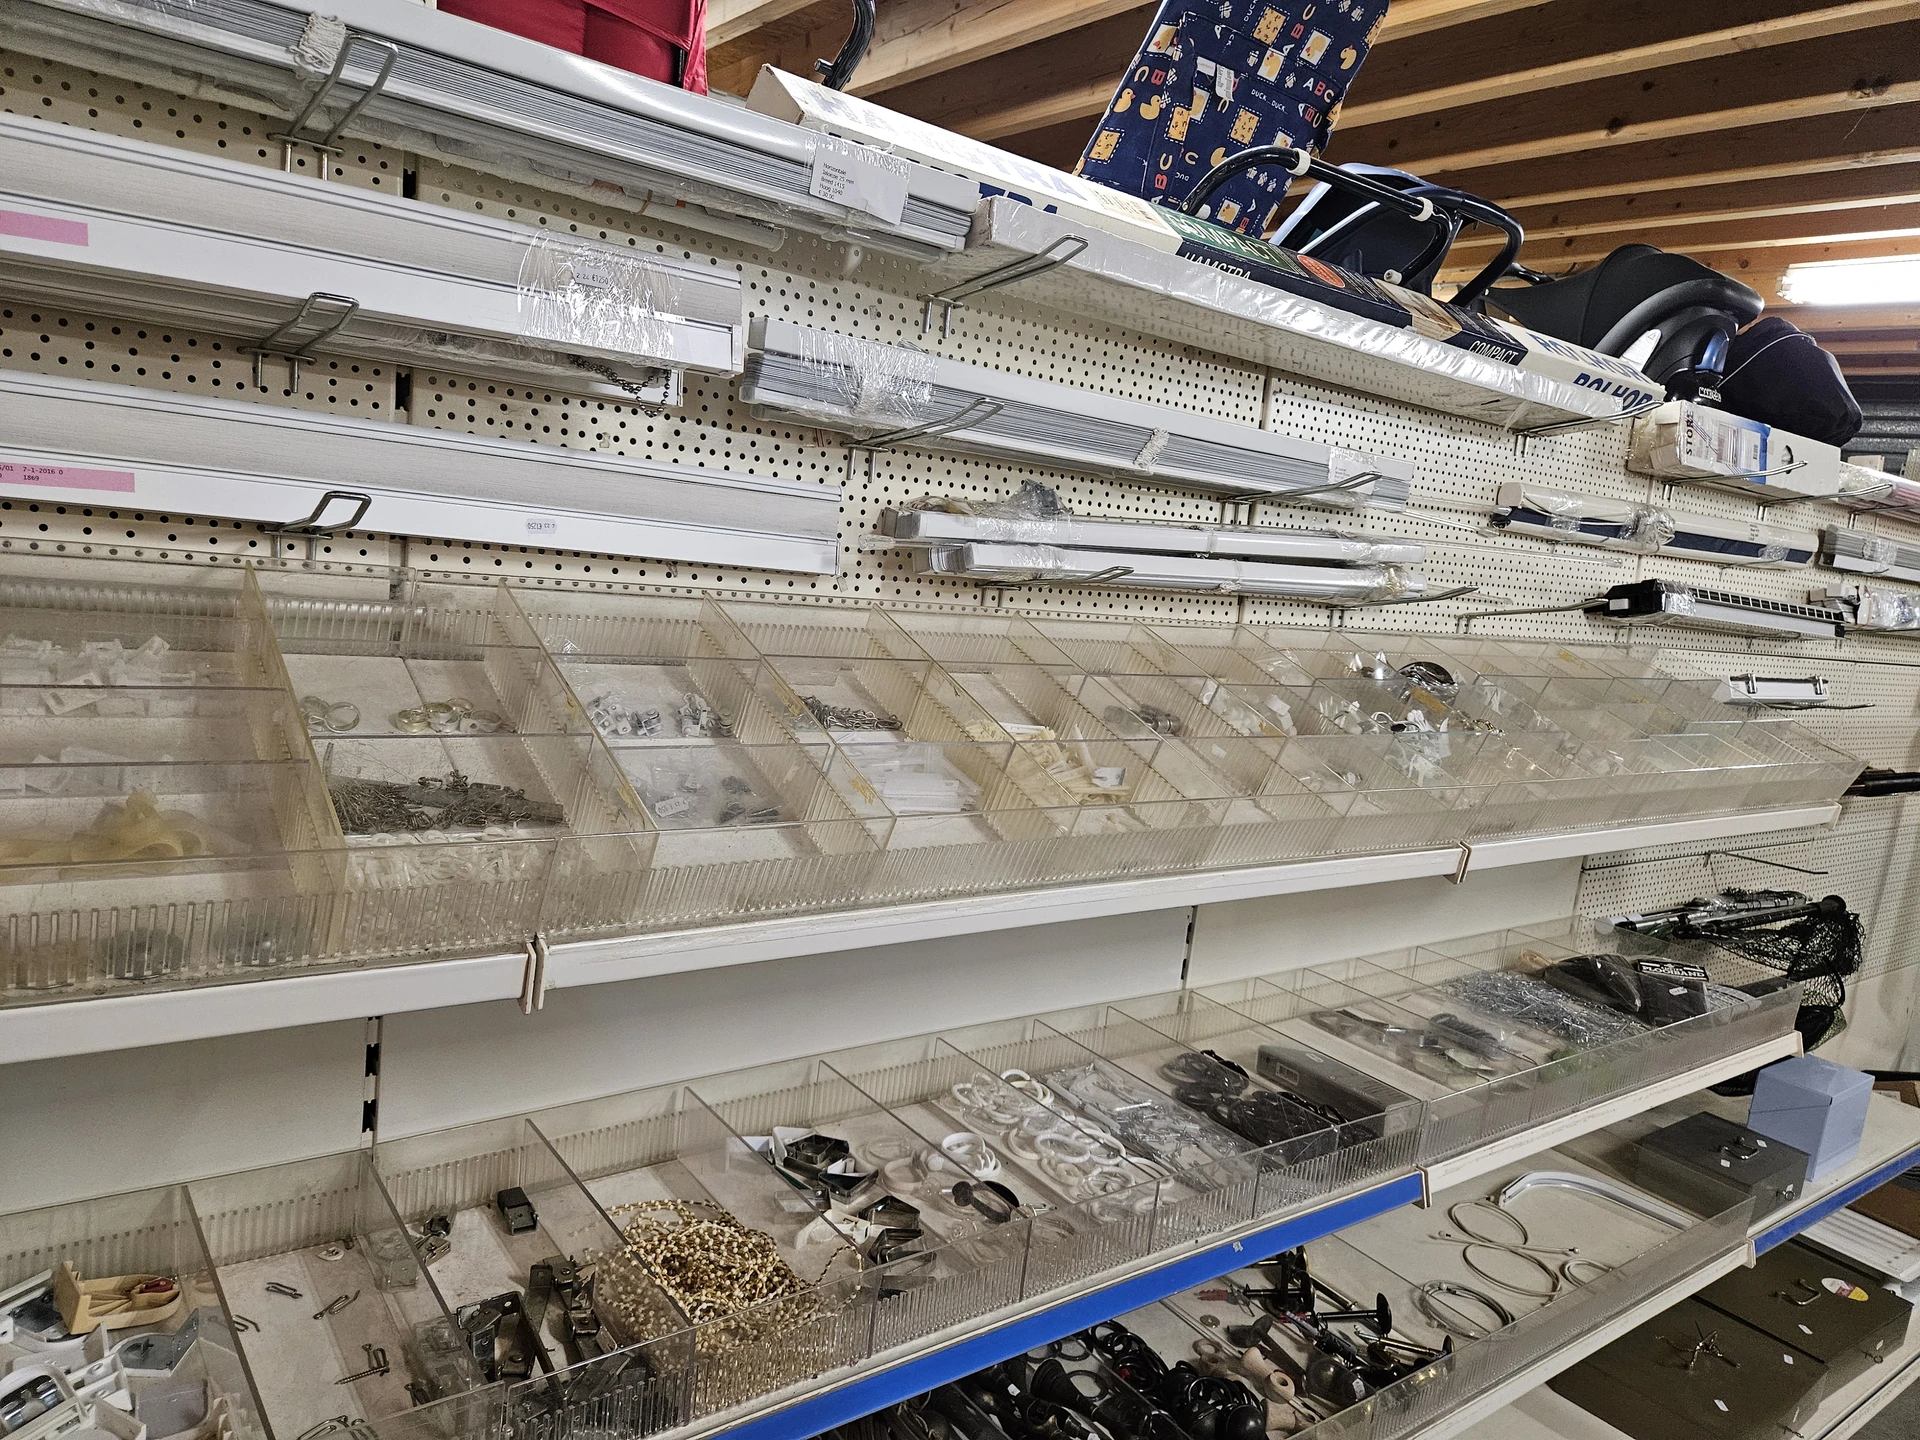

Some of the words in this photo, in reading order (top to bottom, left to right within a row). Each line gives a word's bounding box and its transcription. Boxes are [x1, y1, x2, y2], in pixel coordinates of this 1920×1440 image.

[821, 176, 833, 186] Breed
[819, 183, 832, 193] Hoog
[1685, 409, 1695, 456] STORE
[22, 466, 56, 475] 7-1-2016
